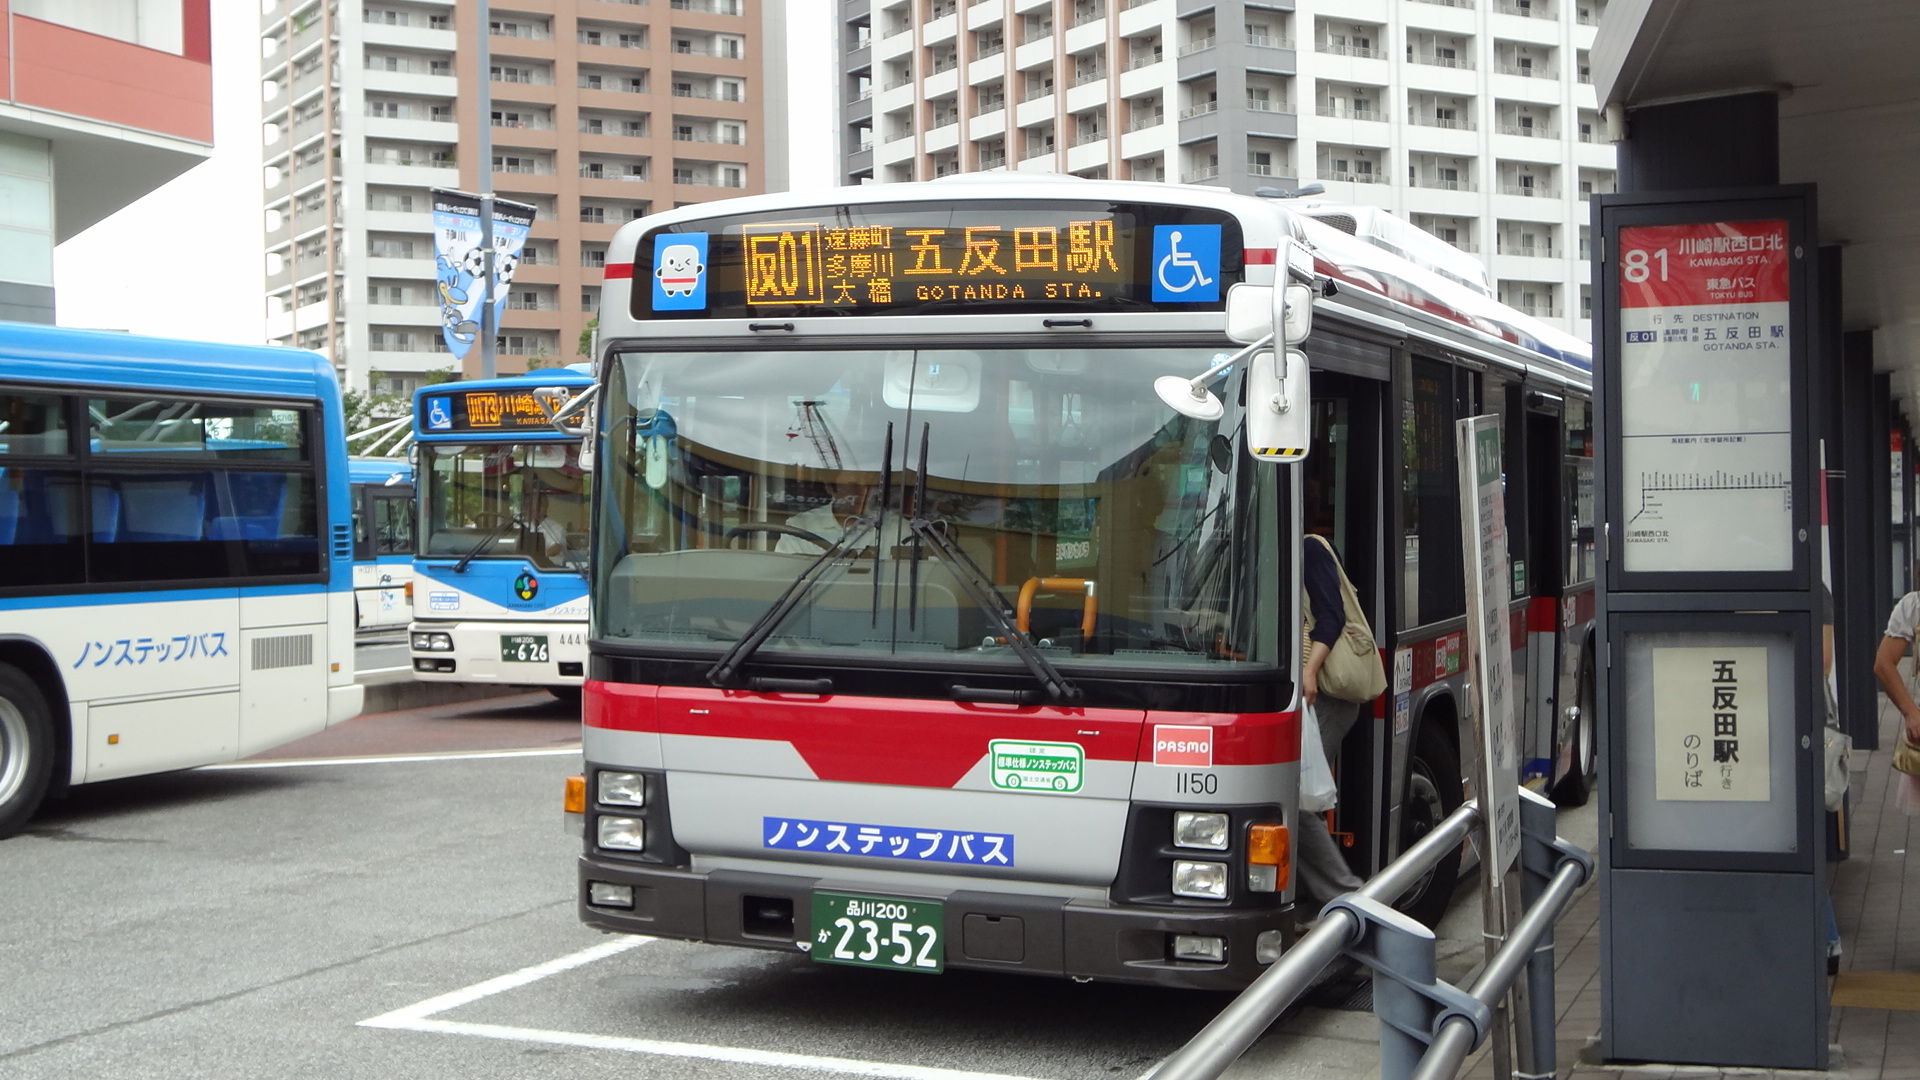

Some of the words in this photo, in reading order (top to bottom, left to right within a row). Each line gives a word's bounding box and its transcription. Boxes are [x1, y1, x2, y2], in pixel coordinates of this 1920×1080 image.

[824, 225, 893, 250] 遠藤町
[904, 220, 1119, 275] 五反田駅
[1679, 234, 1784, 255] 川崎駅西口北
[826, 252, 894, 278] 多摩川
[1624, 248, 1669, 283] 81
[1689, 255, 1744, 267] KAWASAKI
[1746, 255, 1771, 265] STA.
[832, 278, 892, 303] 大橋
[916, 284, 1025, 300] GOTANDA
[1045, 282, 1102, 298] STA.
[1706, 277, 1756, 291] 東急バス
[1710, 292, 1735, 300] TOKYU
[1737, 291, 1754, 299] BUS
[1692, 311, 1760, 322] DESTINATION
[1703, 325, 1785, 341] 五反田駅
[1703, 342, 1752, 352] GOTANDA
[1755, 341, 1780, 350] STA.
[72, 632, 229, 669] ノンステップバス
[1157, 741, 1209, 753] PASMO
[1683, 733, 1703, 788] のりば
[1176, 772, 1218, 794] 1150
[768, 822, 1009, 864] ノンステップバス
[846, 900, 908, 920] 品川200
[817, 928, 832, 944] か
[834, 918, 937, 968] 23-52
